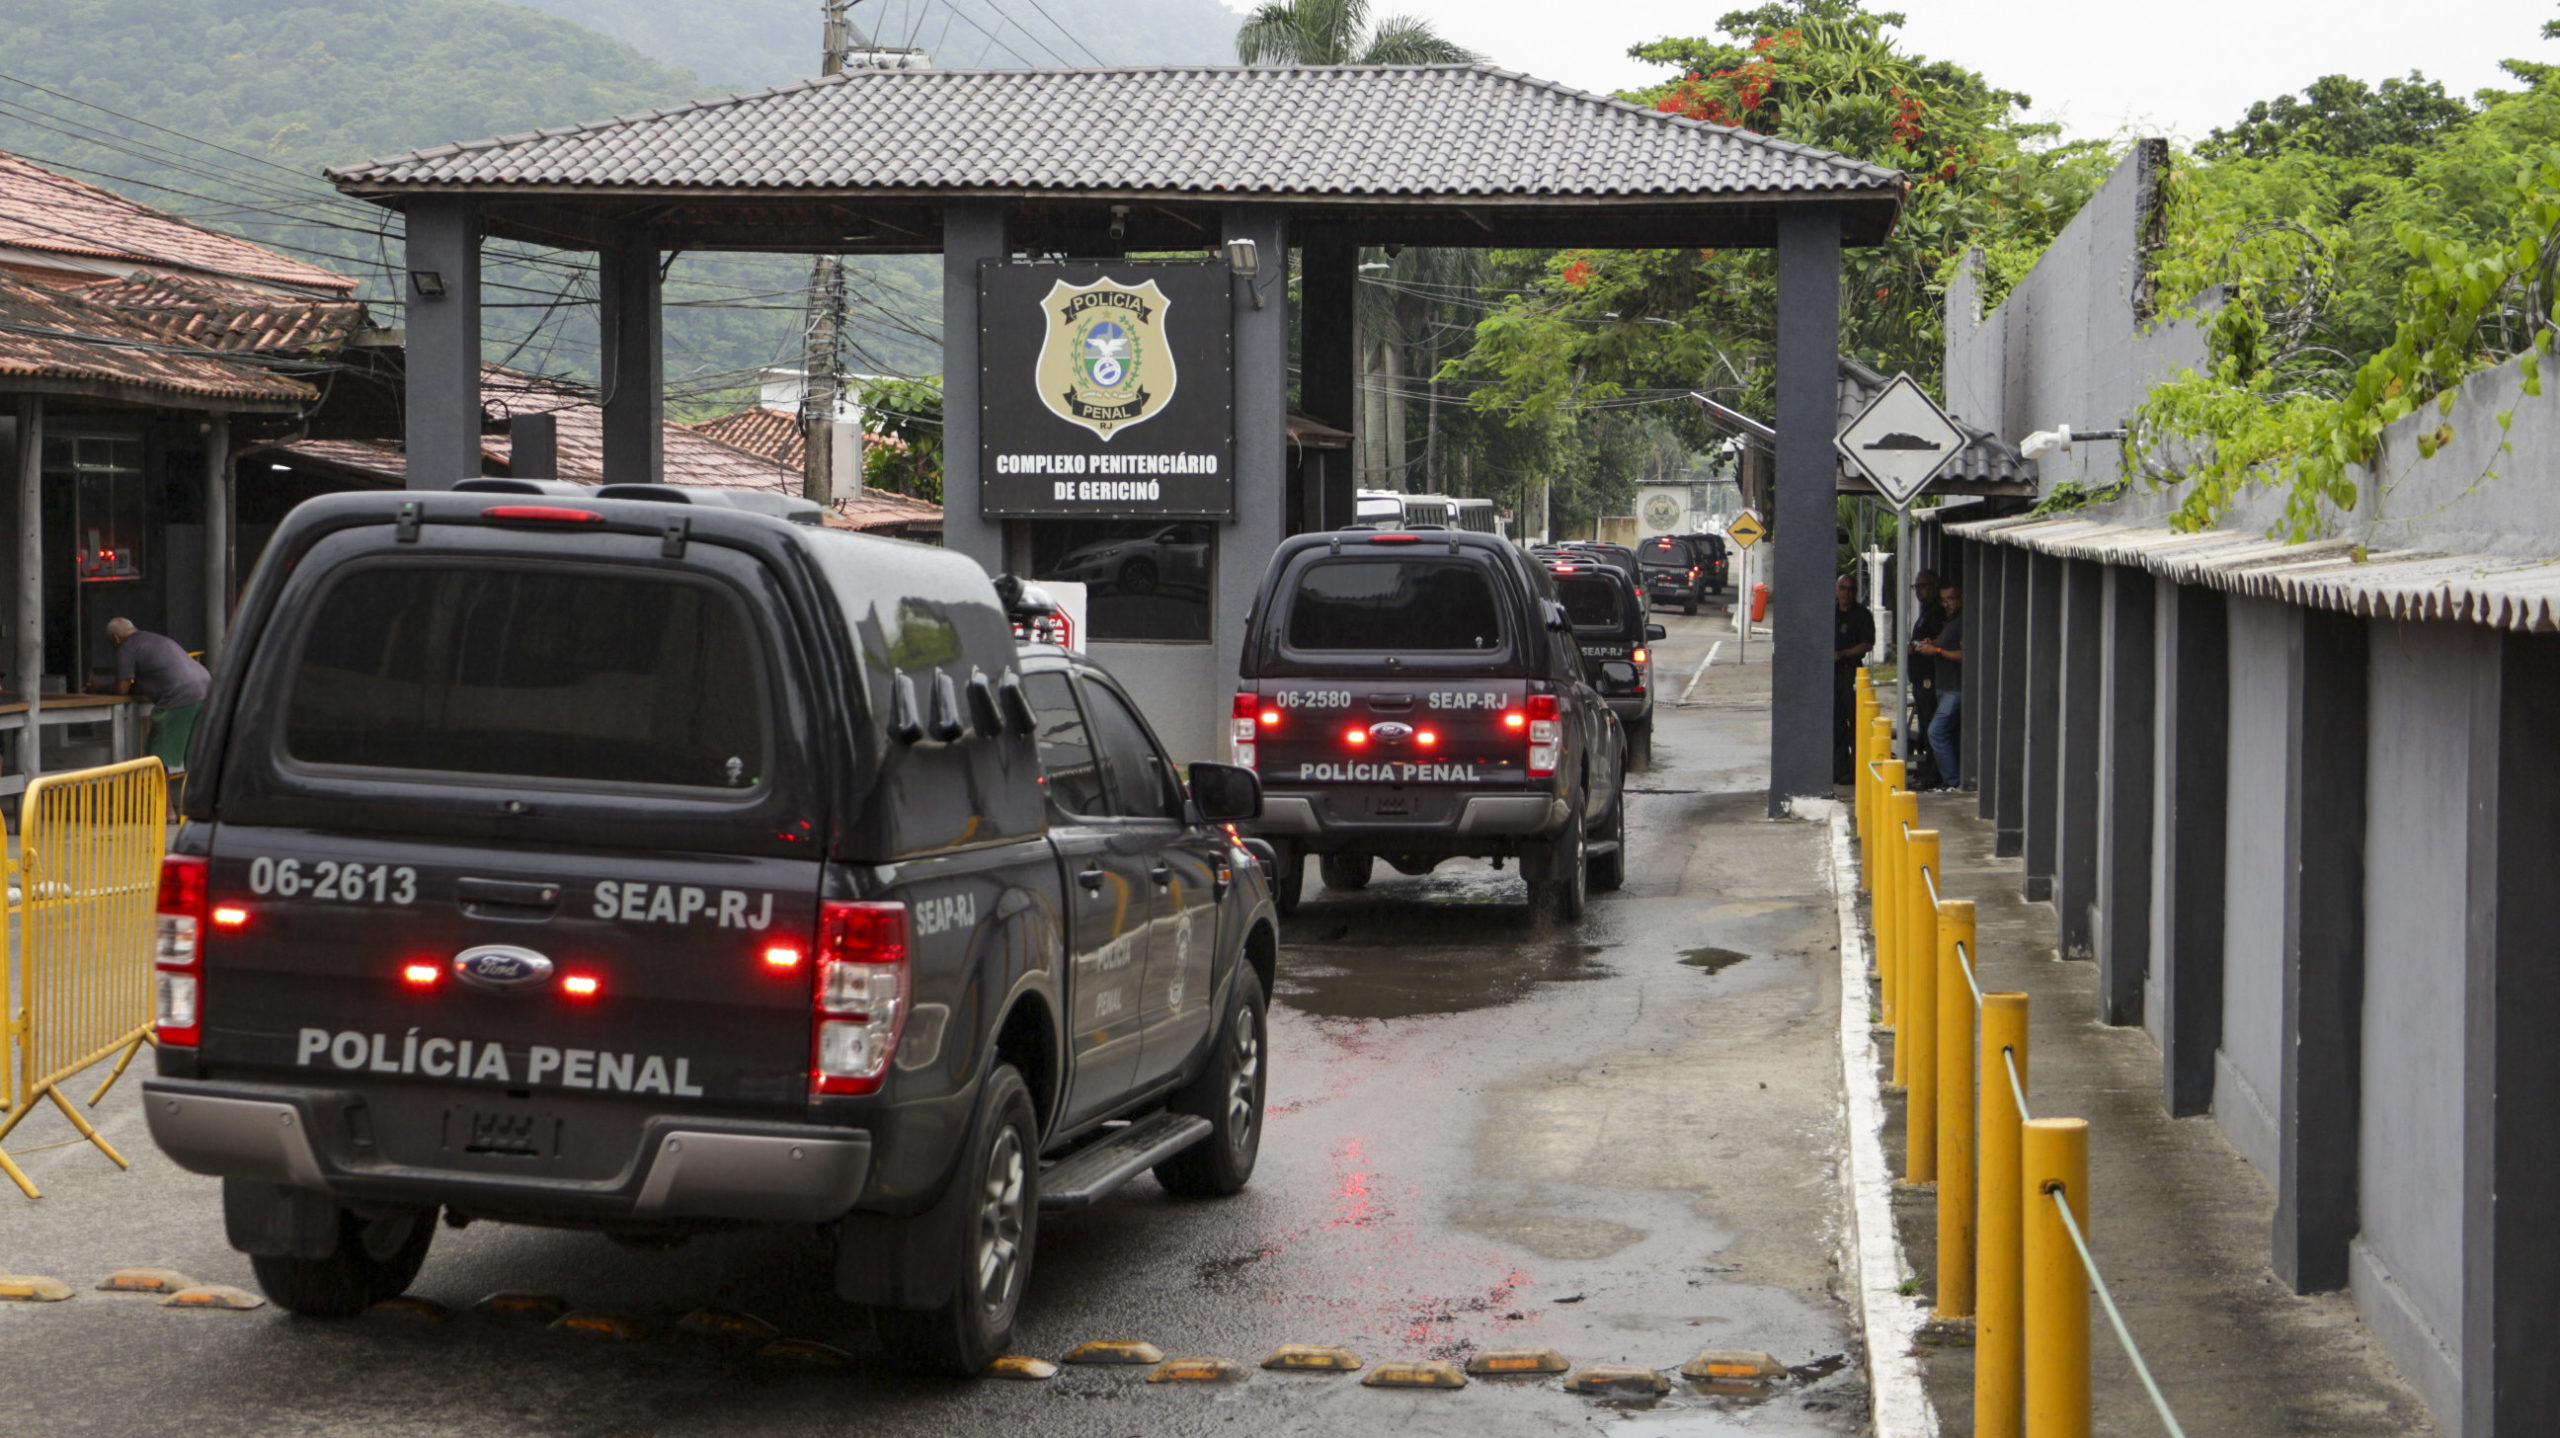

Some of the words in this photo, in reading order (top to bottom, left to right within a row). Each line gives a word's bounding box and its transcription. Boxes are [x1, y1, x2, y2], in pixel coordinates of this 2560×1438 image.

[1082, 405, 1131, 419] PENAL
[996, 455, 1086, 474] COMPLEXO
[1090, 452, 1218, 474] PENITENCIÁRIO
[1054, 482, 1076, 500] DE
[1079, 479, 1160, 500] GERICINÓ
[1276, 691, 1352, 708] 06-2580
[1428, 692, 1507, 710] SEAP-RJ
[1300, 760, 1395, 781] POLÍCIA
[1403, 764, 1480, 782] PENAL
[249, 856, 418, 905] 06-2613
[592, 880, 774, 931] SEAP-RJ
[916, 892, 975, 936] SEAP-RJ
[475, 955, 521, 979] Ford
[296, 1027, 511, 1082] POLÍCIA
[527, 1045, 704, 1098] PENAL
